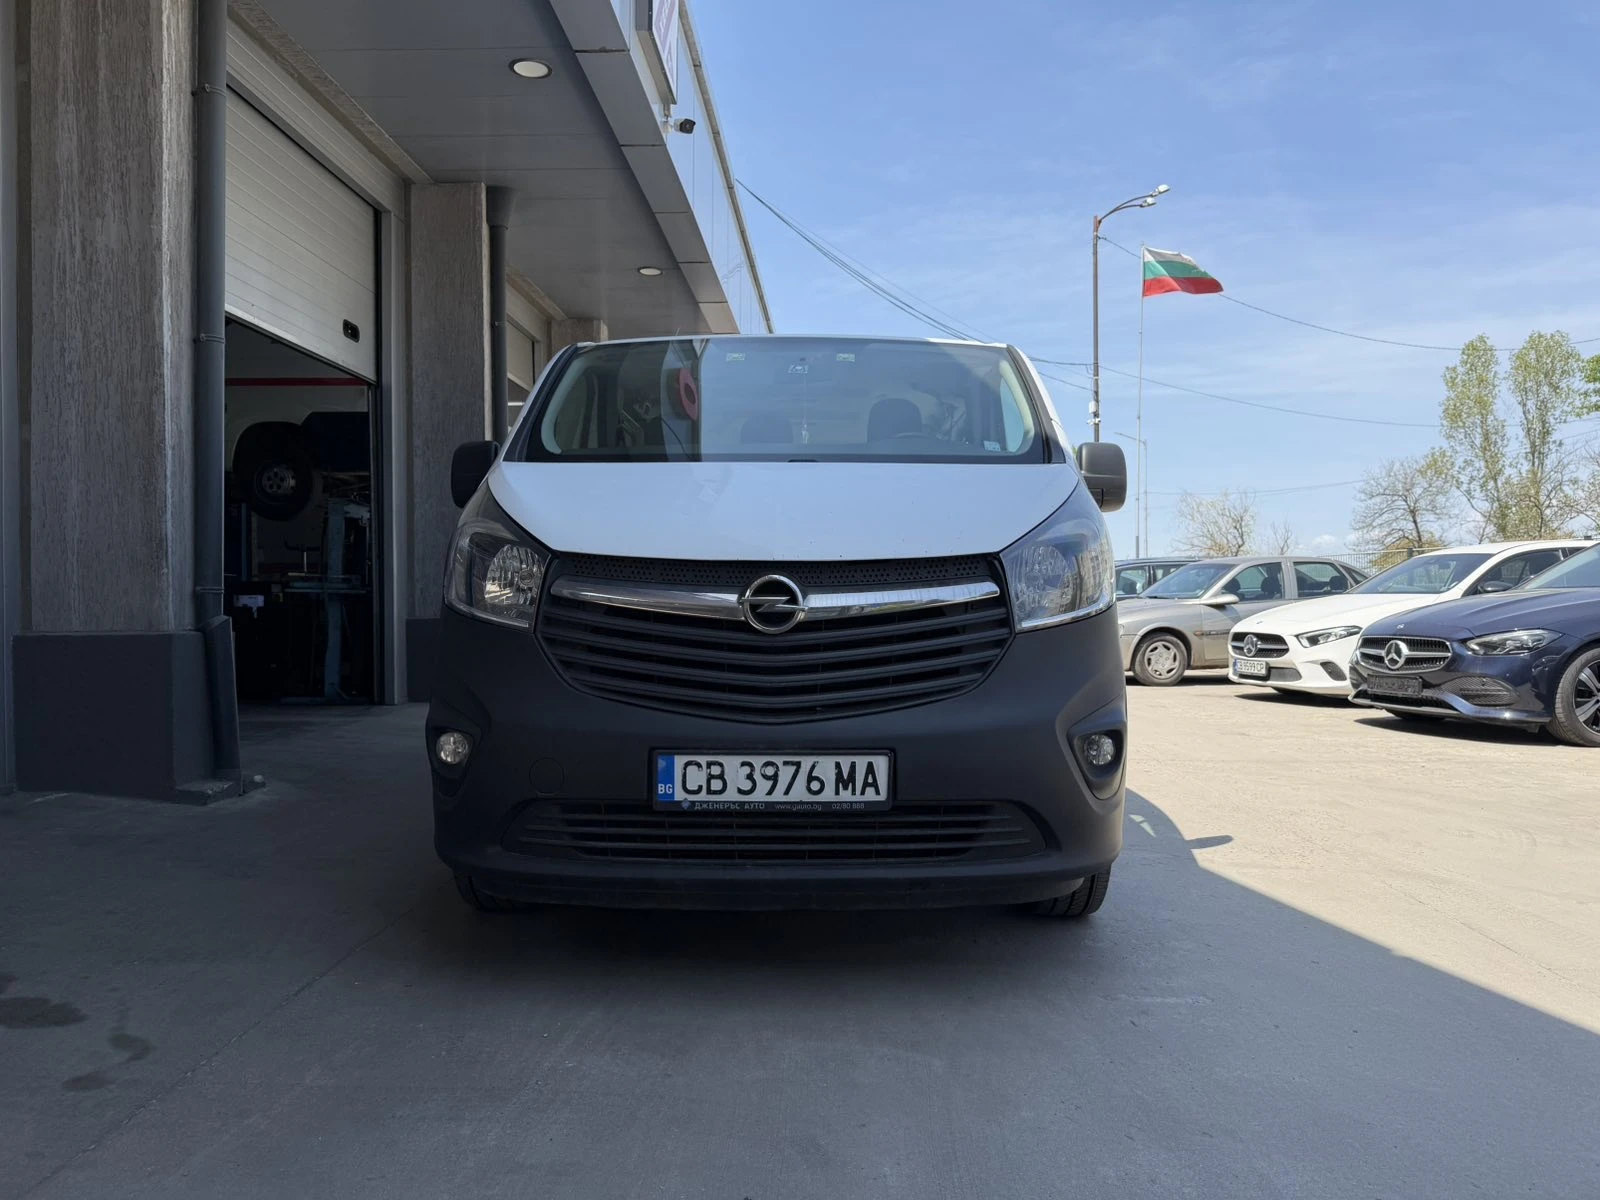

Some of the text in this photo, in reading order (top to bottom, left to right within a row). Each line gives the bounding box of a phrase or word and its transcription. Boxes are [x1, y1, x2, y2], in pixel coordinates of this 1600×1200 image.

[1256, 662, 1264, 672] CP
[681, 760, 881, 796] CB 3976 MA
[658, 784, 673, 794] BG
